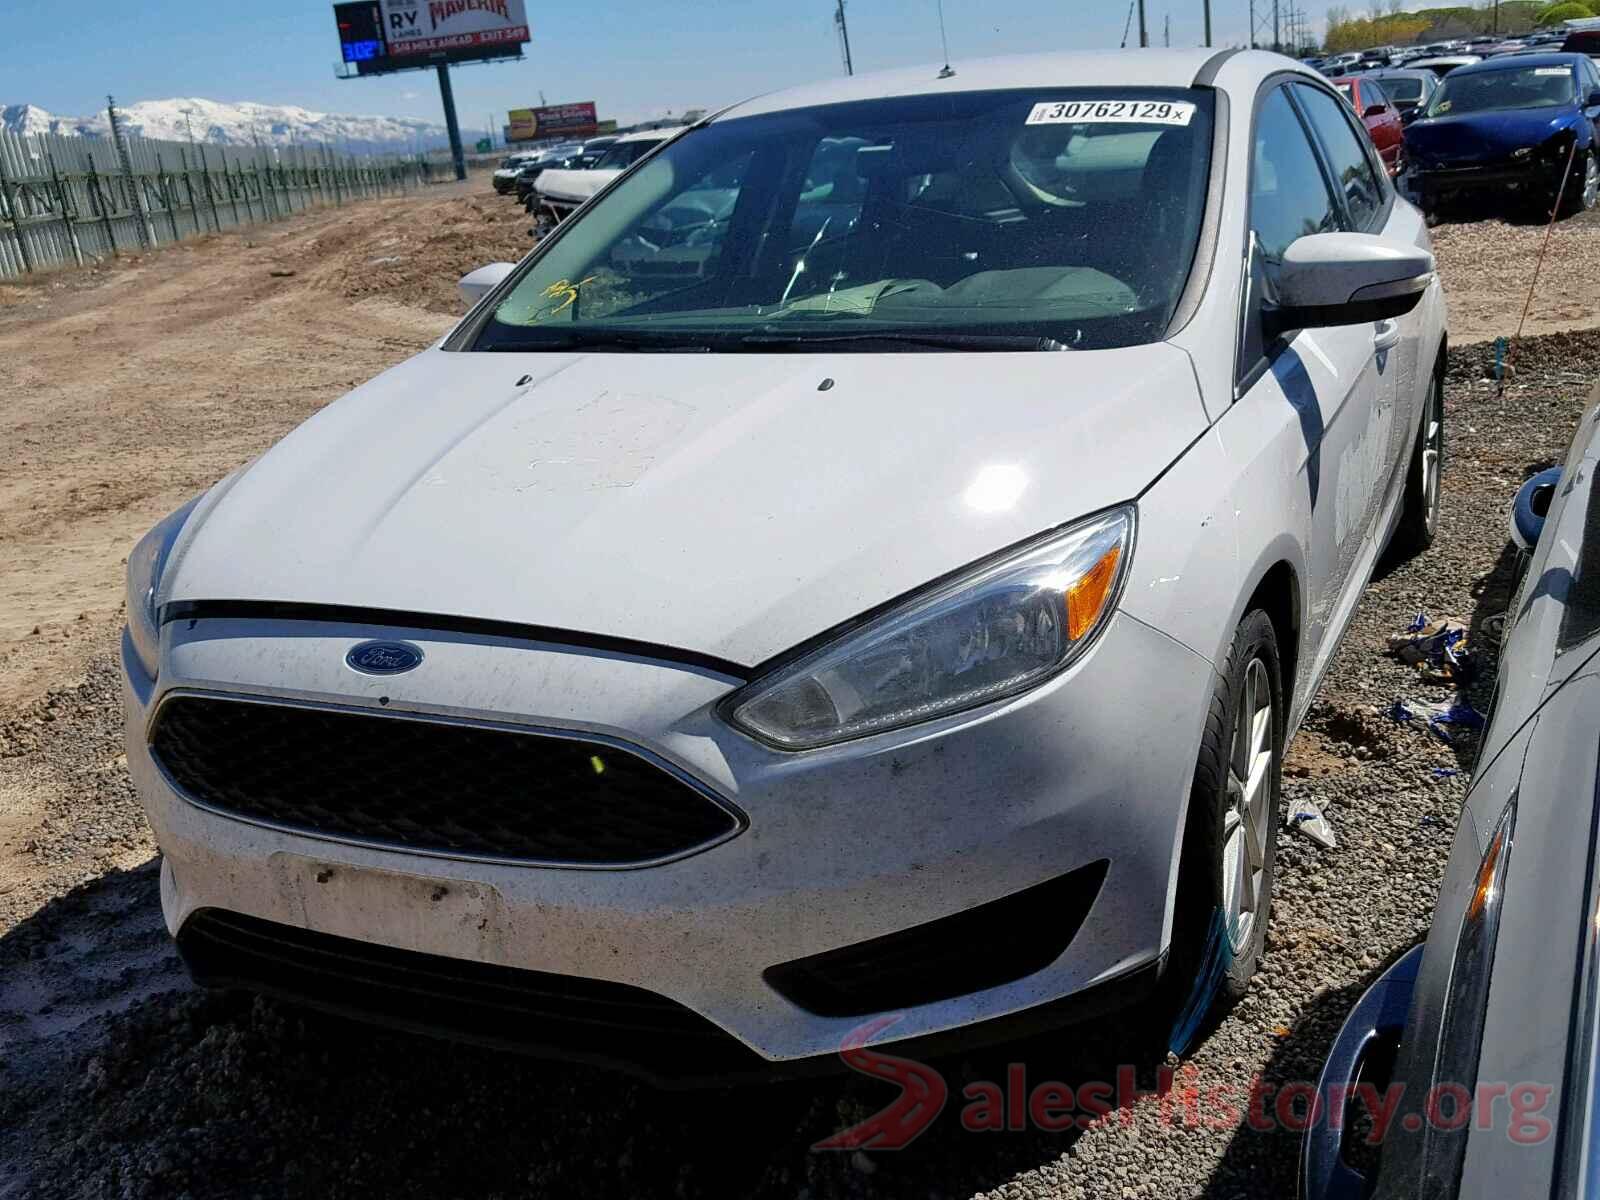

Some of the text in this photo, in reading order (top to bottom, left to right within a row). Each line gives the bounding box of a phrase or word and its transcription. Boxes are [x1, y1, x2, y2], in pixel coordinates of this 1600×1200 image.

[389, 11, 418, 29] RV
[412, 39, 437, 50] MILE
[439, 34, 473, 48] AHEAD
[480, 30, 504, 42] EXIT
[360, 647, 404, 667] Ford
